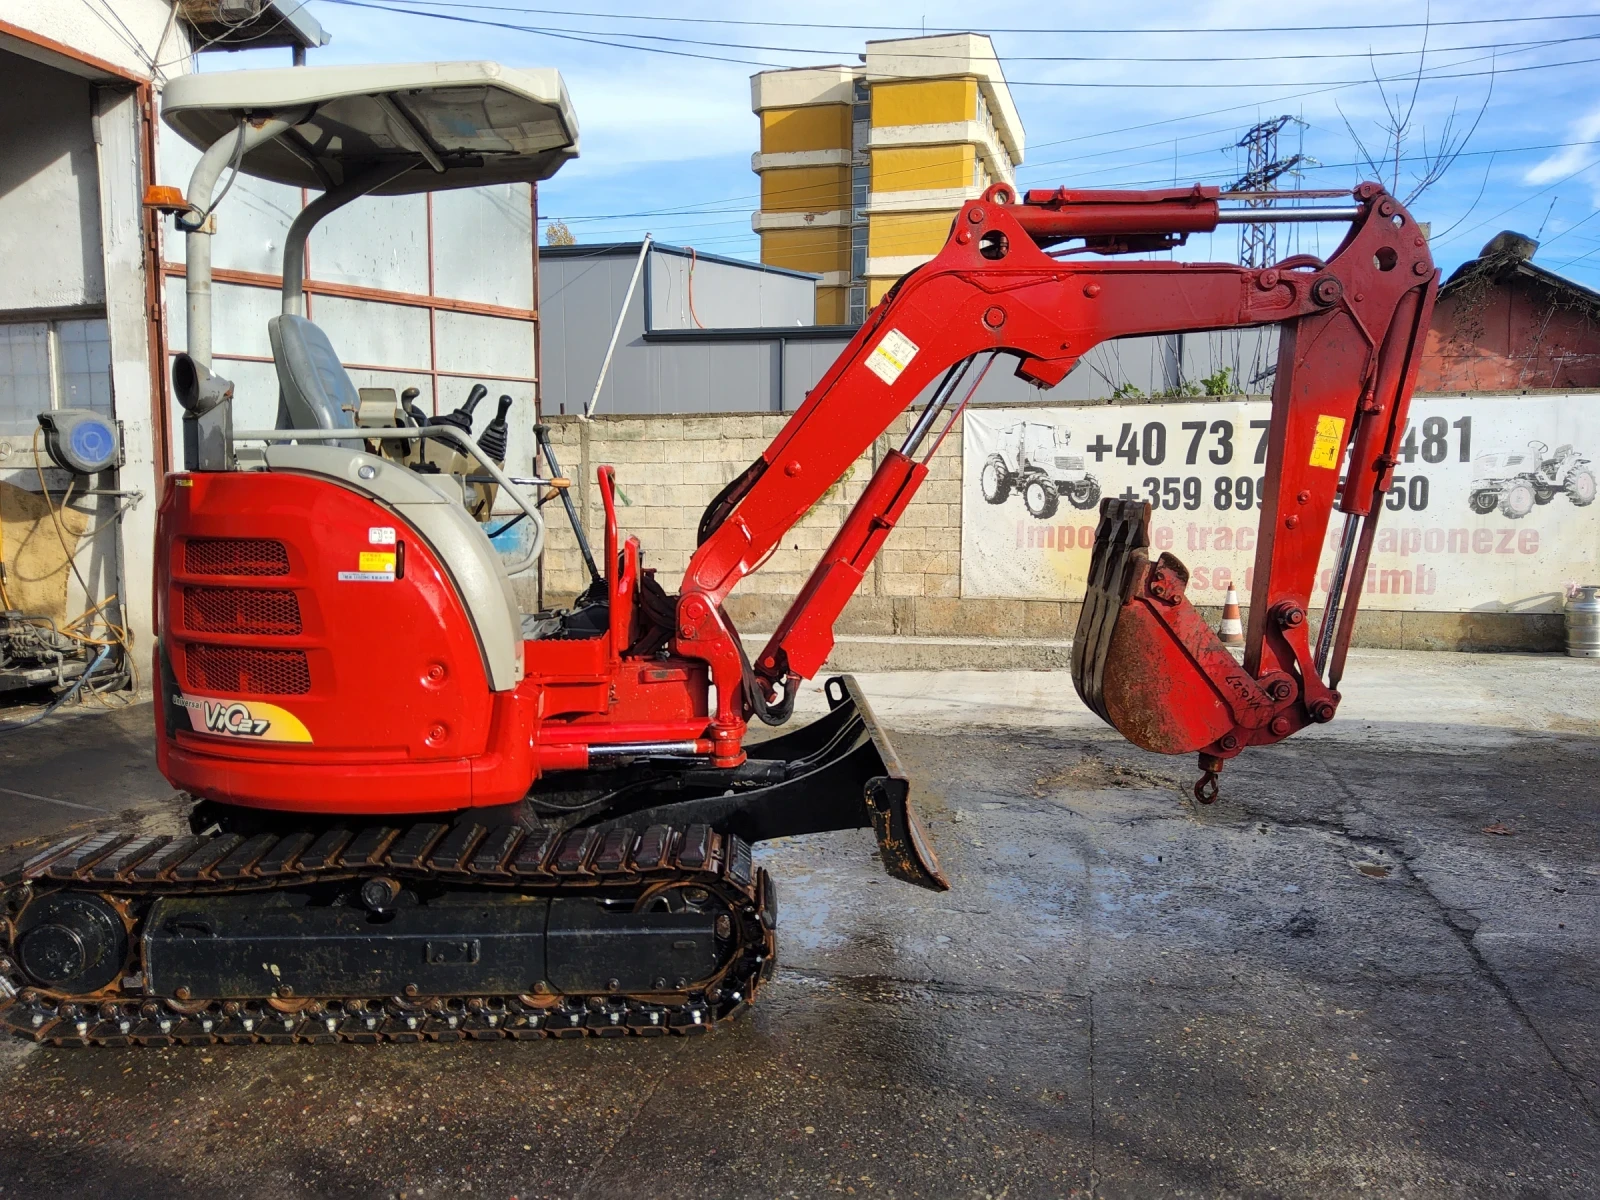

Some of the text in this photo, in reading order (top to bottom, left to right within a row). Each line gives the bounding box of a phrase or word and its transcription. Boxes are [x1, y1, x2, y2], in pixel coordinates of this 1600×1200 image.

[1086, 420, 1167, 467] +40
[1181, 419, 1234, 466] 73
[1249, 419, 1272, 465] 7
[1396, 415, 1473, 464] 481
[1118, 476, 1202, 511] +359
[1385, 475, 1430, 511] 50
[1016, 520, 1095, 552] Impo
[1186, 521, 1255, 551] trac
[1377, 527, 1540, 557] aponeze
[172, 694, 202, 710] Universal
